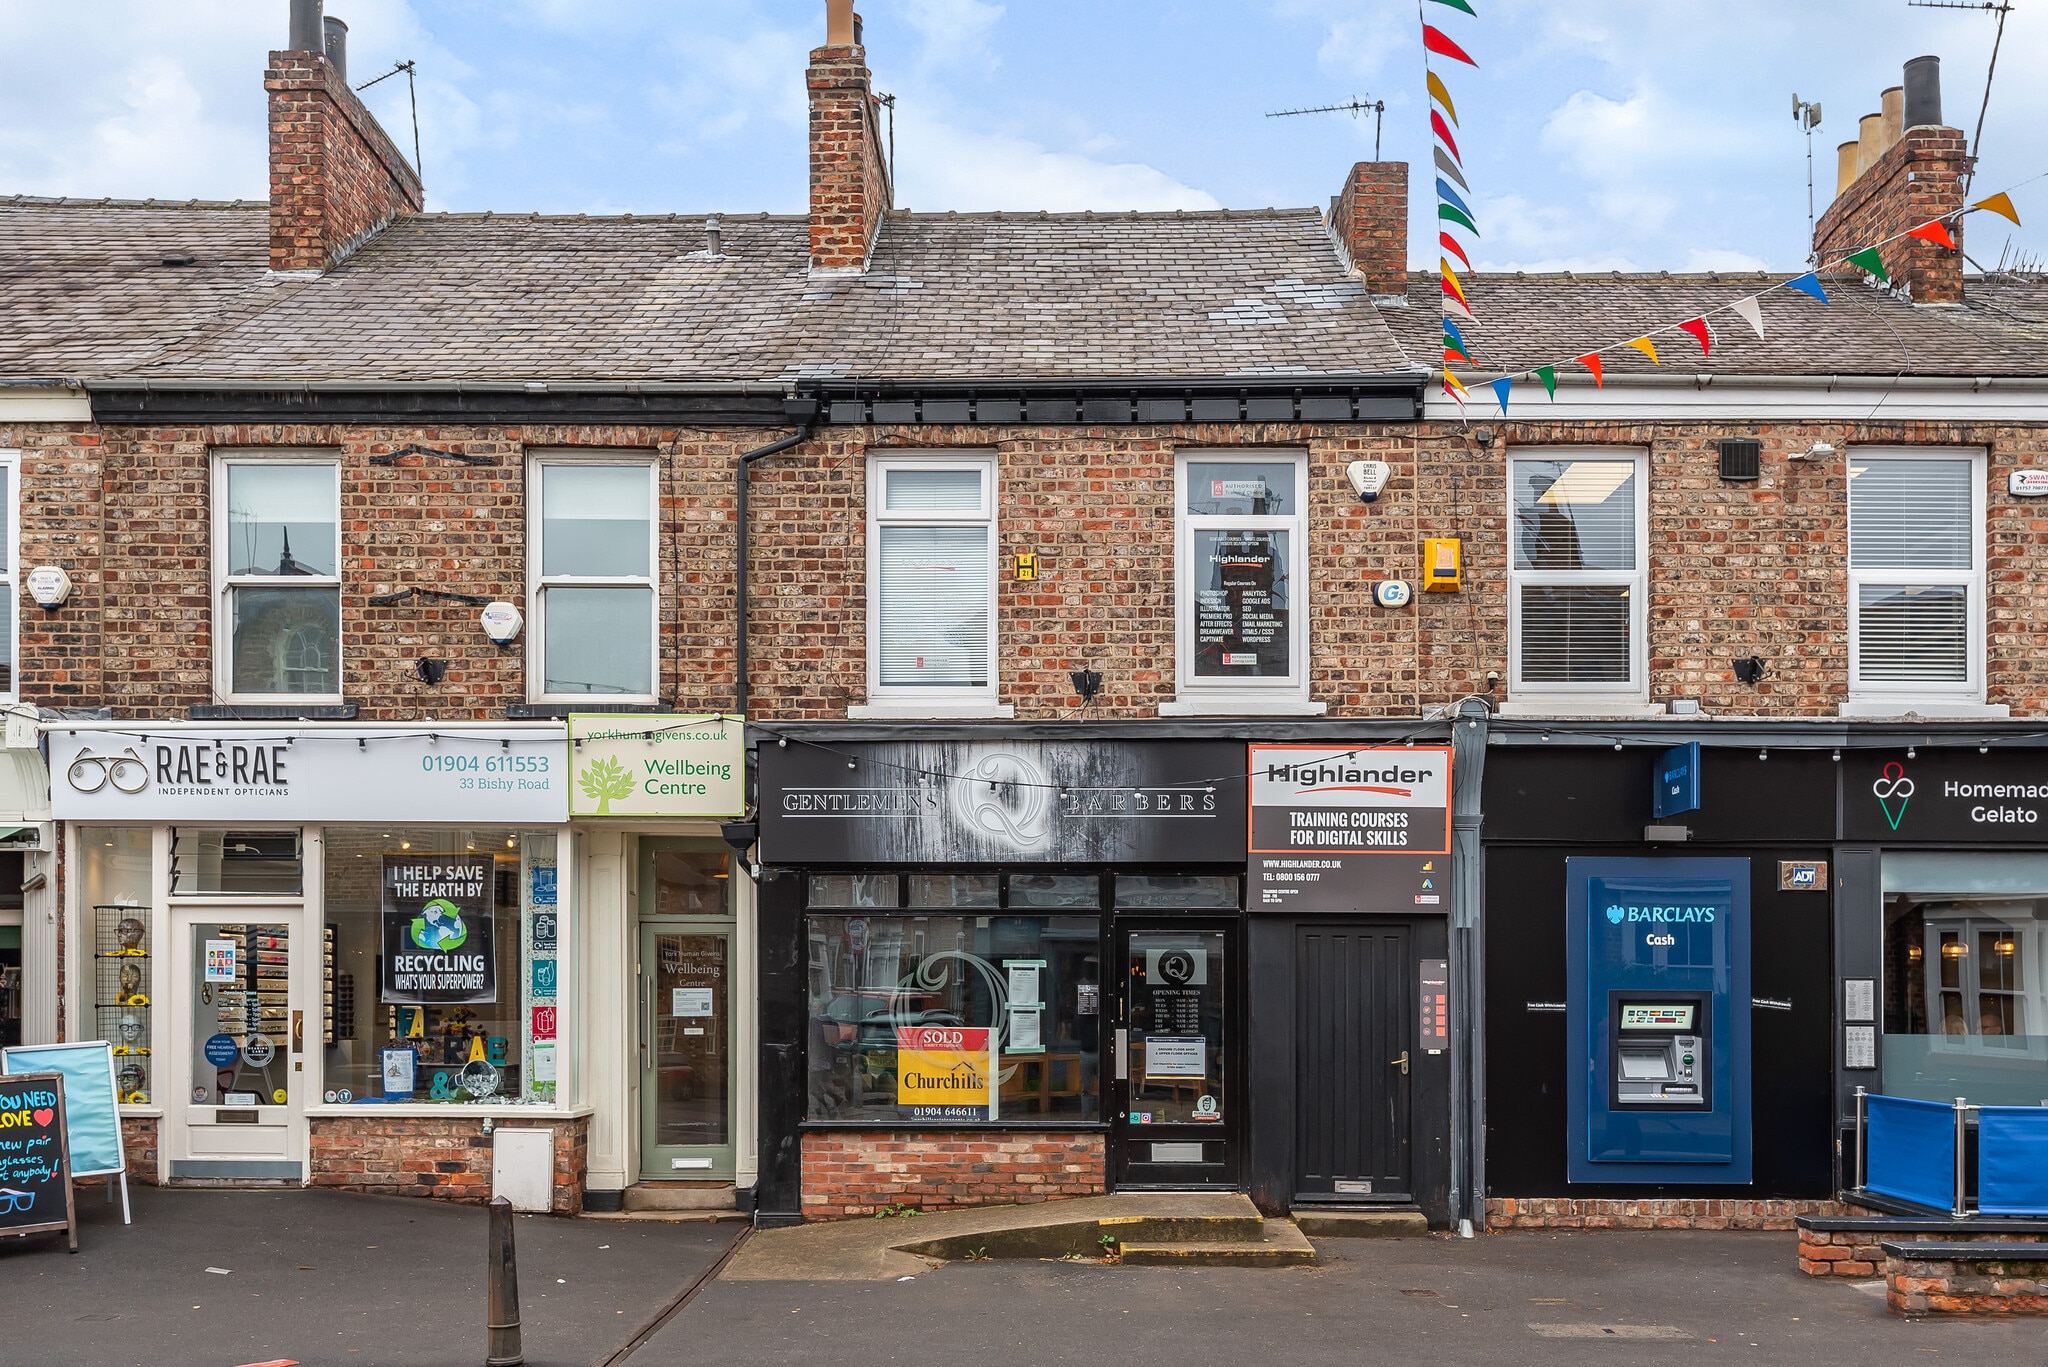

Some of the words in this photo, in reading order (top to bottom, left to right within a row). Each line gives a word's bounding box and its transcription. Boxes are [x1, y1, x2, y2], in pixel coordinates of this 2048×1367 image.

[1209, 555, 1271, 564] Highlander
[1022, 569, 1029, 577] 21
[156, 745, 213, 785] RAE
[215, 751, 229, 778] &
[232, 745, 289, 785] RAE
[422, 755, 480, 772] 01904
[485, 755, 549, 772] 611553
[644, 759, 731, 780] Wellbeing
[1268, 764, 1433, 786] Highlander
[158, 788, 230, 796] INDEPENDENT
[235, 788, 289, 796] OPTICIANS
[459, 778, 474, 789] 33
[478, 777, 514, 792] Bishy
[518, 778, 550, 789] Road
[644, 779, 706, 795] Centre
[957, 753, 1048, 846] Q
[1066, 794, 1216, 811] BARBERS
[1290, 812, 1348, 828] TRAINING
[1351, 812, 1409, 828] COURSES
[1971, 805, 2038, 823] Gelato
[1290, 830, 1314, 845] FOR
[1317, 830, 1364, 845] DIGITAL
[1366, 831, 1408, 846] SKILLS
[1263, 860, 1342, 869] WWW.HIGHLANDER.CO.UK
[394, 866, 398, 880] I
[403, 866, 441, 880] HELP
[445, 866, 484, 880] SAVE
[1263, 873, 1275, 882] TEL:
[1276, 873, 1293, 882] 0800
[1794, 870, 1815, 882] ADT
[395, 882, 419, 897] THE
[422, 882, 464, 897] EARTH
[467, 882, 484, 897] BY
[1627, 906, 1715, 923] BARCLAYS
[1646, 933, 1675, 946] Cash
[394, 954, 485, 972] RECYCLING
[665, 962, 721, 978] Wellbeing
[1165, 956, 1189, 981] Q
[395, 973, 418, 990] WHAT'S
[419, 973, 436, 990] YOUR
[437, 973, 484, 990] SUPERPOWER?
[679, 979, 706, 987] Centre
[923, 1031, 963, 1044] SOLD
[429, 1071, 450, 1100] &
[903, 1072, 984, 1090] Churchills
[23, 1090, 57, 1110] NEED
[914, 1107, 941, 1116] 01904
[944, 1107, 976, 1116] 646611
[26, 1134, 52, 1154] pair
